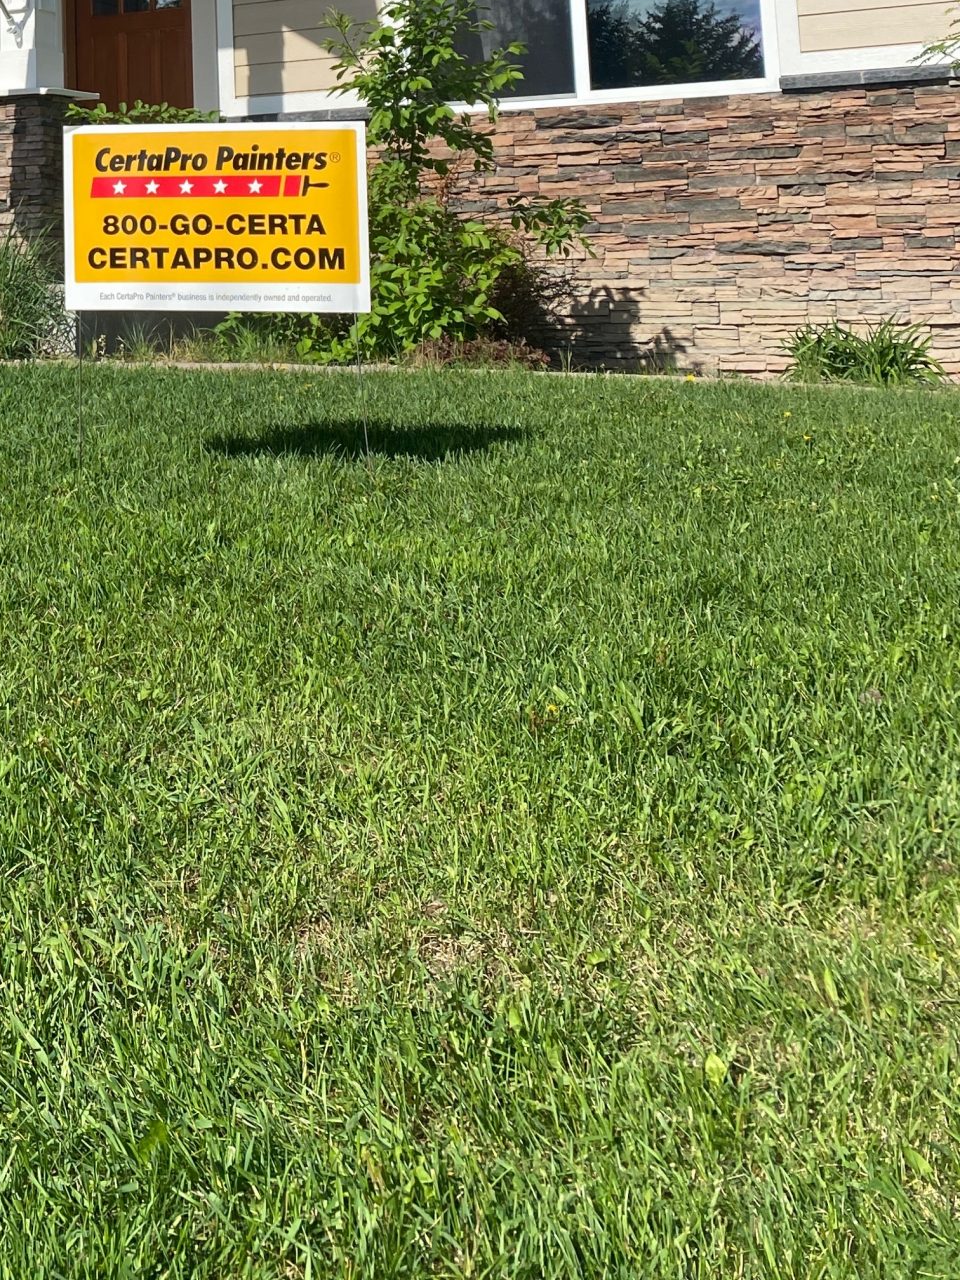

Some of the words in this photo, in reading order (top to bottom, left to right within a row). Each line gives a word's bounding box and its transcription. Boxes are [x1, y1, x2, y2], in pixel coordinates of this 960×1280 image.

[94, 145, 208, 173] CertaPro
[102, 213, 327, 236] 800-GO-CERTA
[87, 247, 346, 271] CERTAPRO.COM
[99, 292, 115, 301] Each
[116, 292, 145, 301] CertaPro
[177, 292, 207, 302] business
[208, 293, 215, 302] is
[215, 293, 261, 304] independently
[263, 294, 286, 303] owned
[286, 294, 300, 303] and
